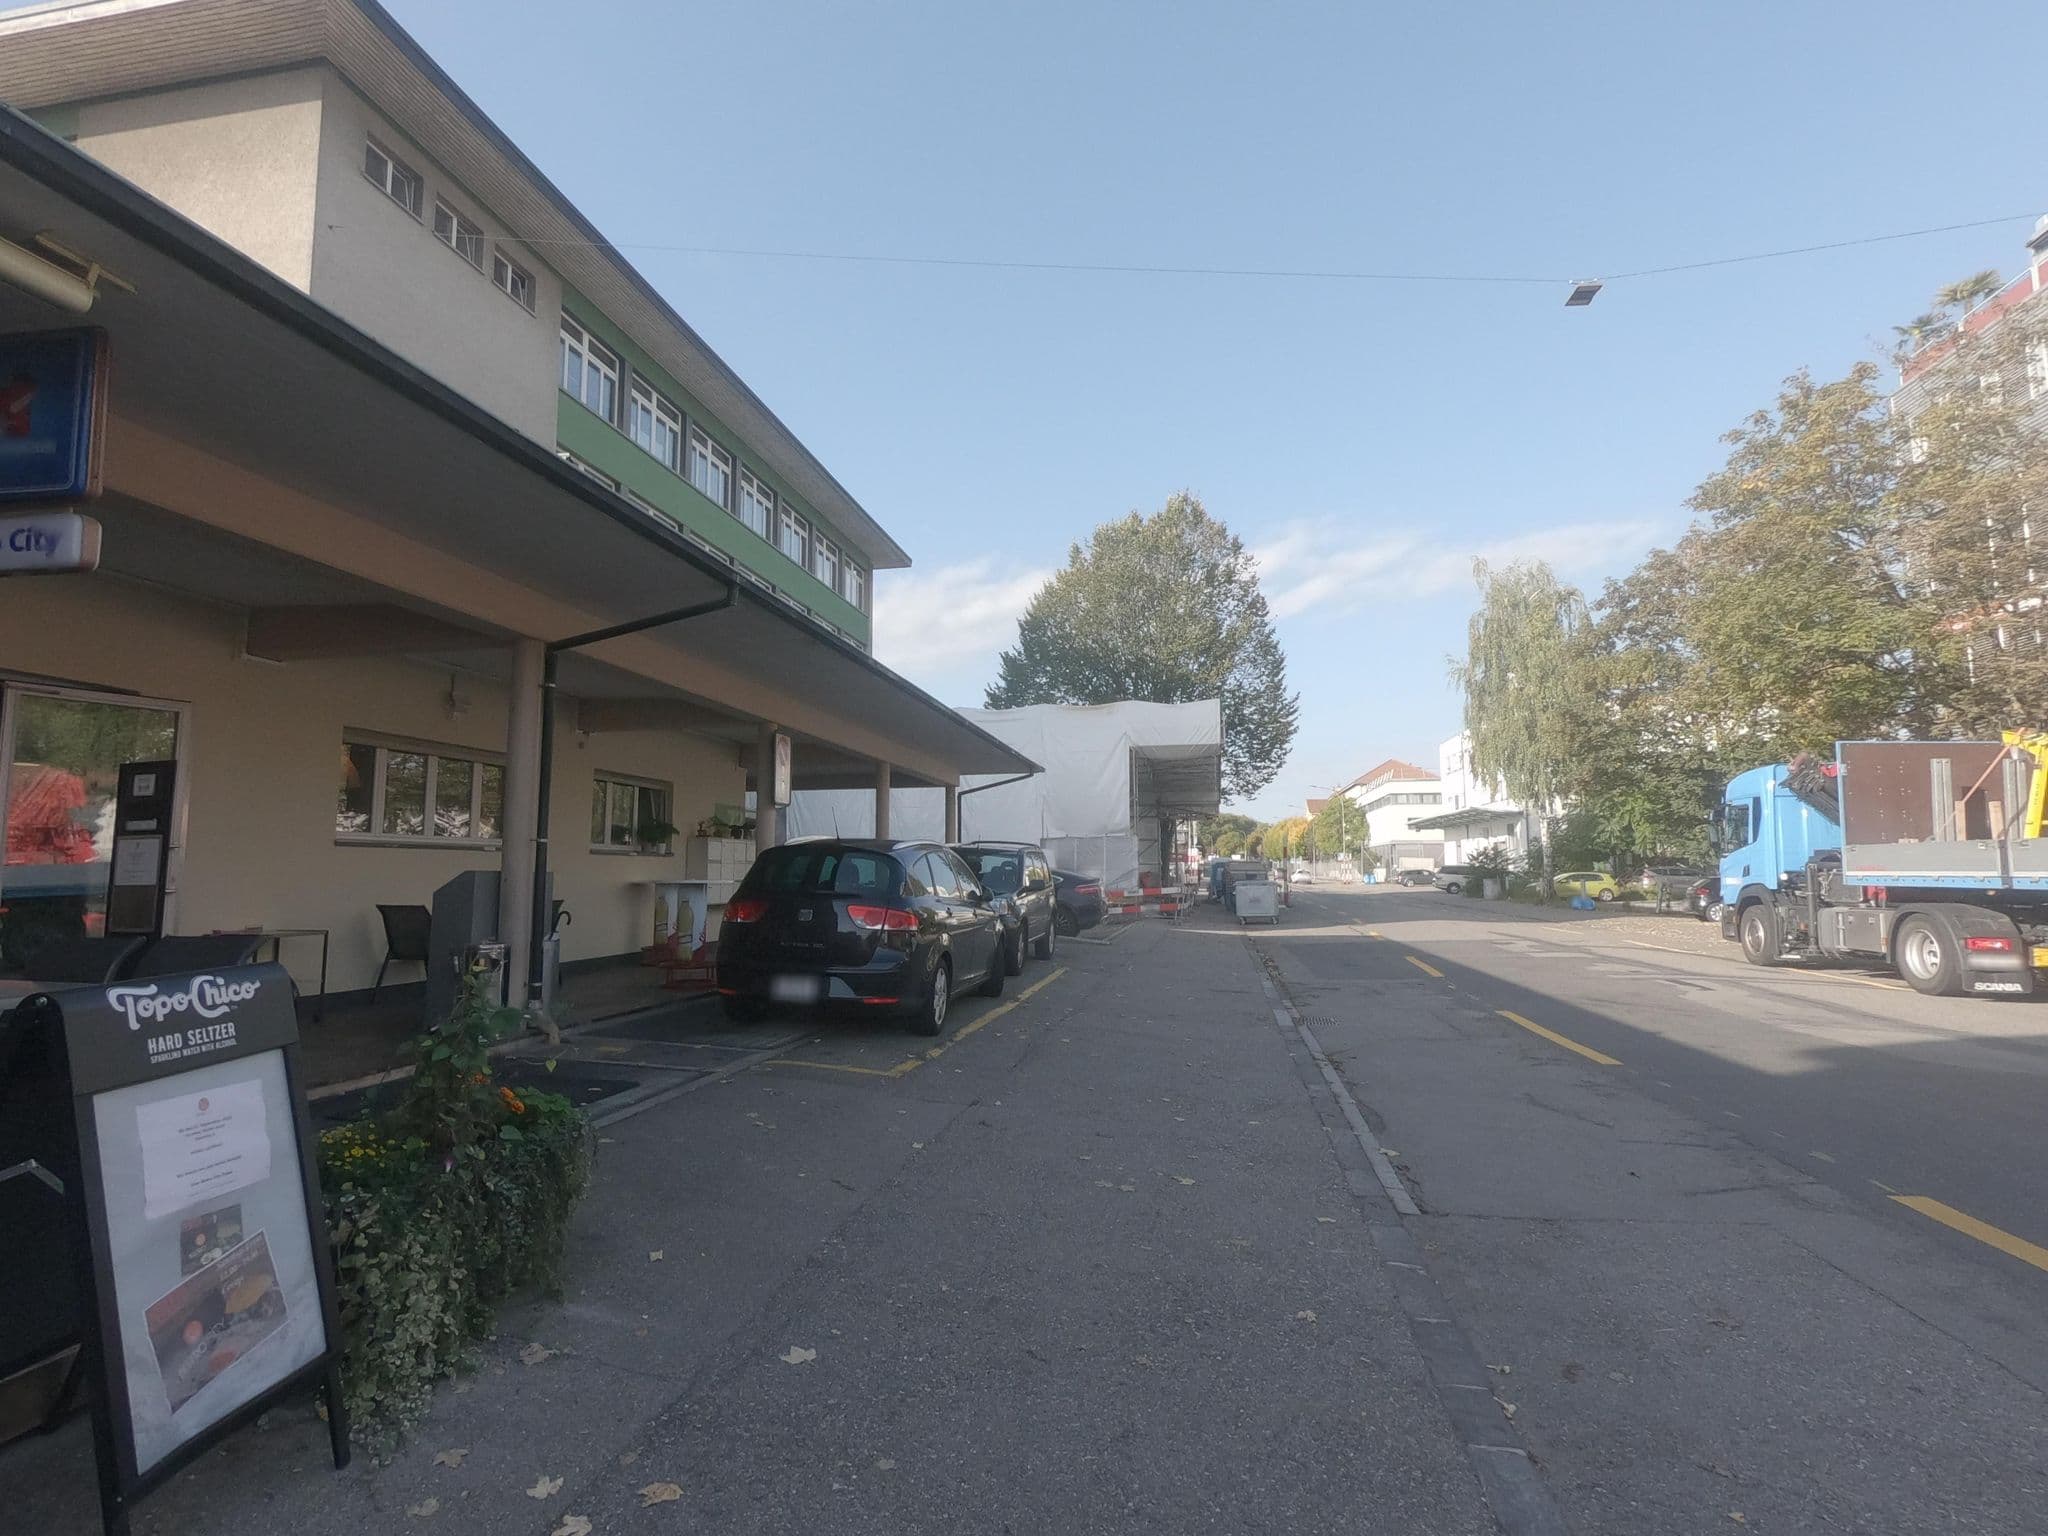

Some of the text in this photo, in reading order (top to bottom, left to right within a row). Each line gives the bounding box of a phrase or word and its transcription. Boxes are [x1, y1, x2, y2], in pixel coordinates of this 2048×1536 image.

[10, 527, 61, 558] City
[1973, 982, 2023, 992] SCANIA
[106, 975, 261, 1031] Topo Chico
[147, 1022, 237, 1054] HARD SELTZER
